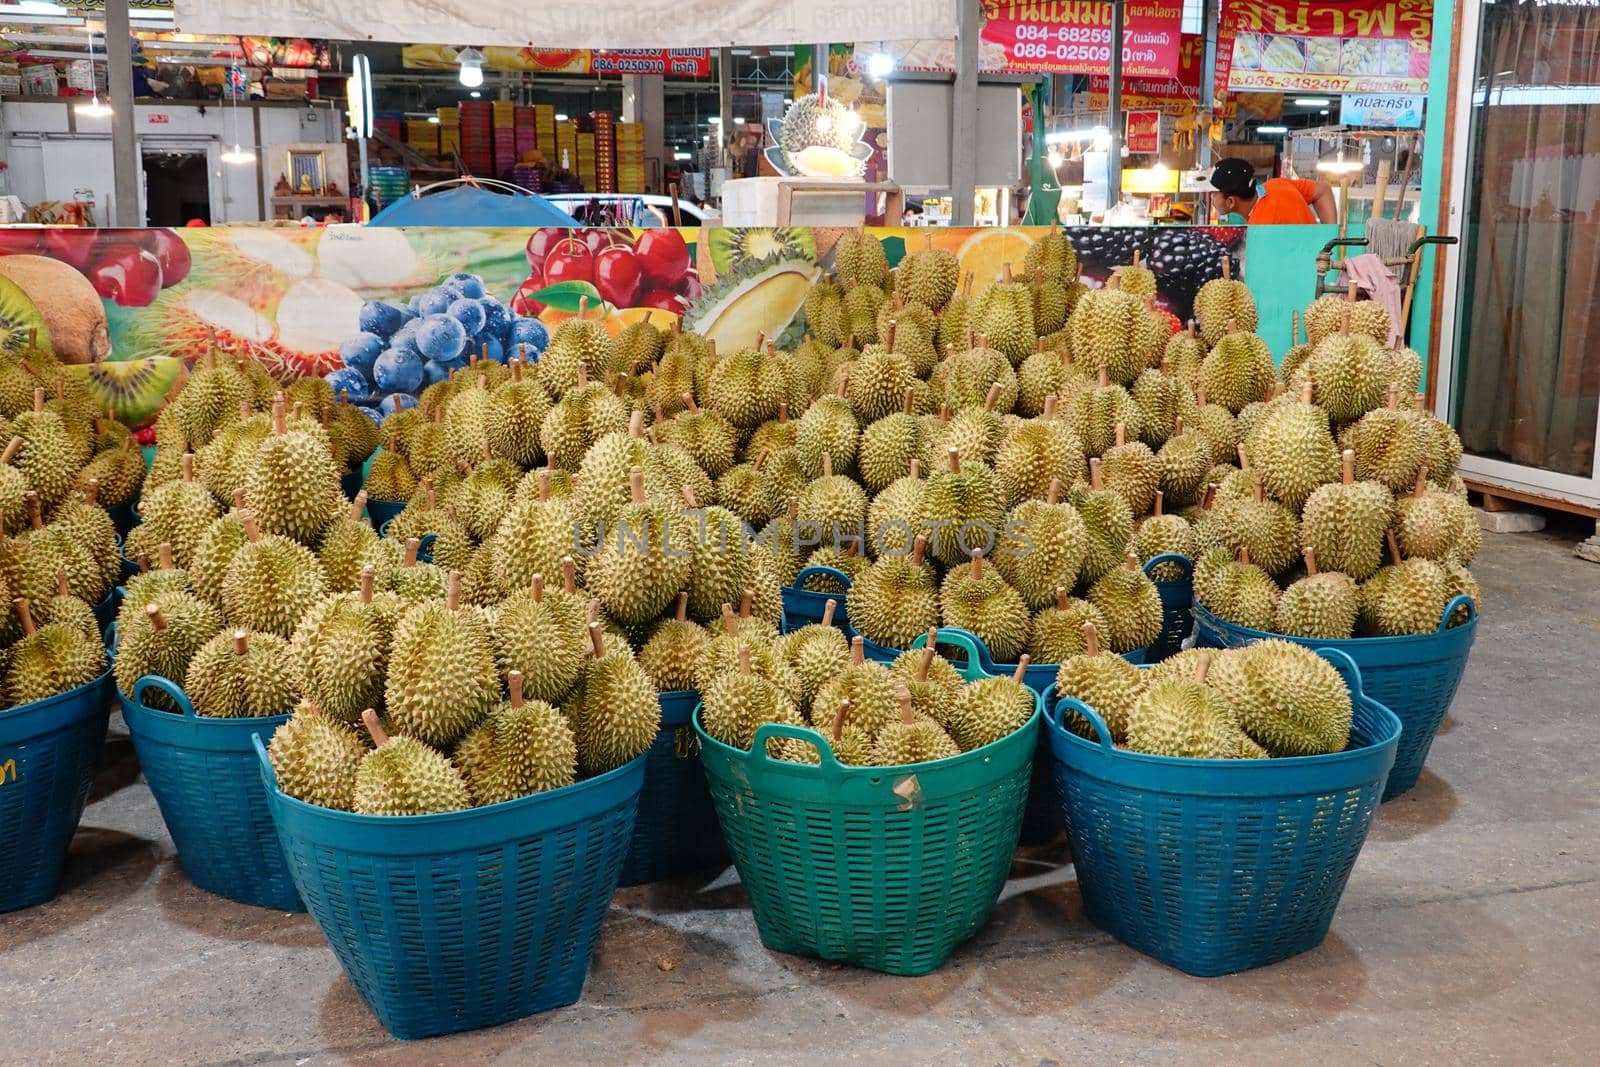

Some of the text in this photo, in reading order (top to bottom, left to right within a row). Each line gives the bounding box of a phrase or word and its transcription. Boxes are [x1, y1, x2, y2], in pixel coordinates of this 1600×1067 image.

[1015, 25, 1133, 45] 084-682597
[1013, 43, 1131, 62] 086-025090
[592, 59, 665, 73] 086-0250910
